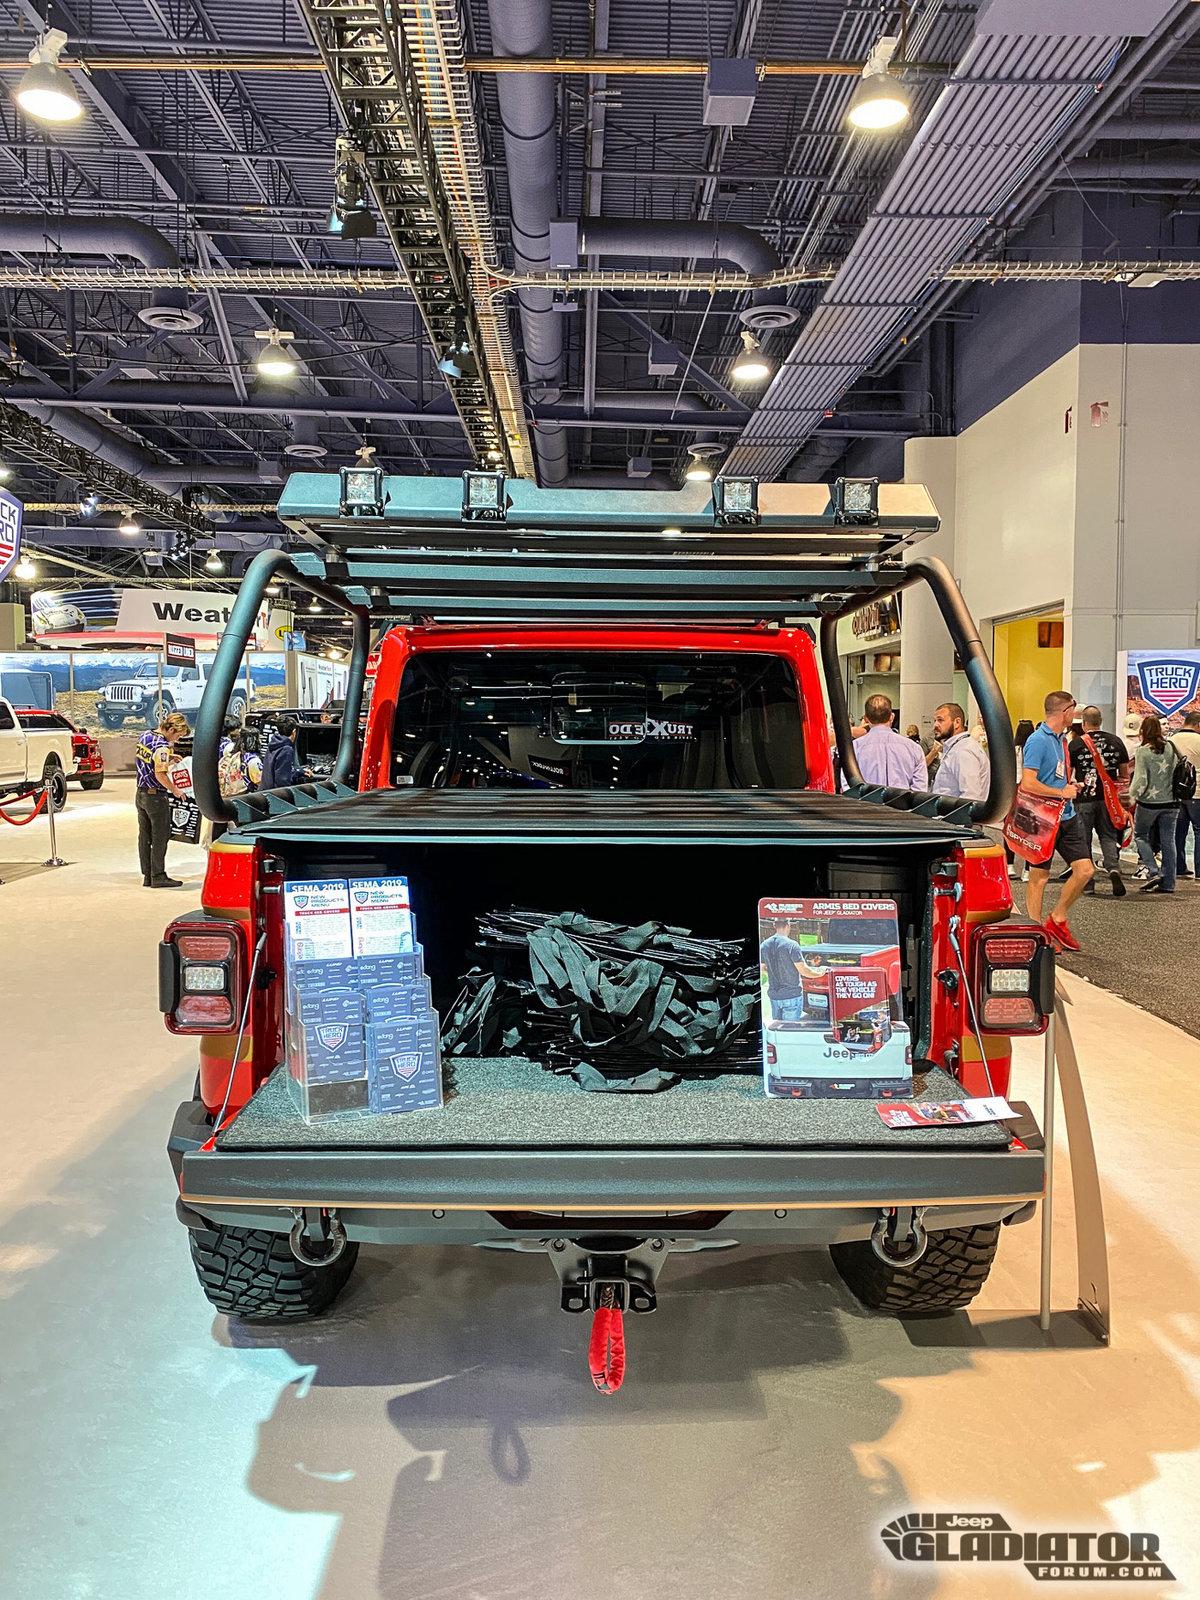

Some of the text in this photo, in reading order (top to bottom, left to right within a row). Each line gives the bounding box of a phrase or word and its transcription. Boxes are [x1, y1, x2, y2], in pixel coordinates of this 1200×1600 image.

[1146, 667, 1192, 677] TRUCK
[1150, 677, 1189, 688] HERO
[1009, 831, 1042, 852] SPYDER
[319, 883, 344, 891] 2019
[352, 879, 402, 889] SEMA 2019
[823, 1047, 855, 1060] Jeep
